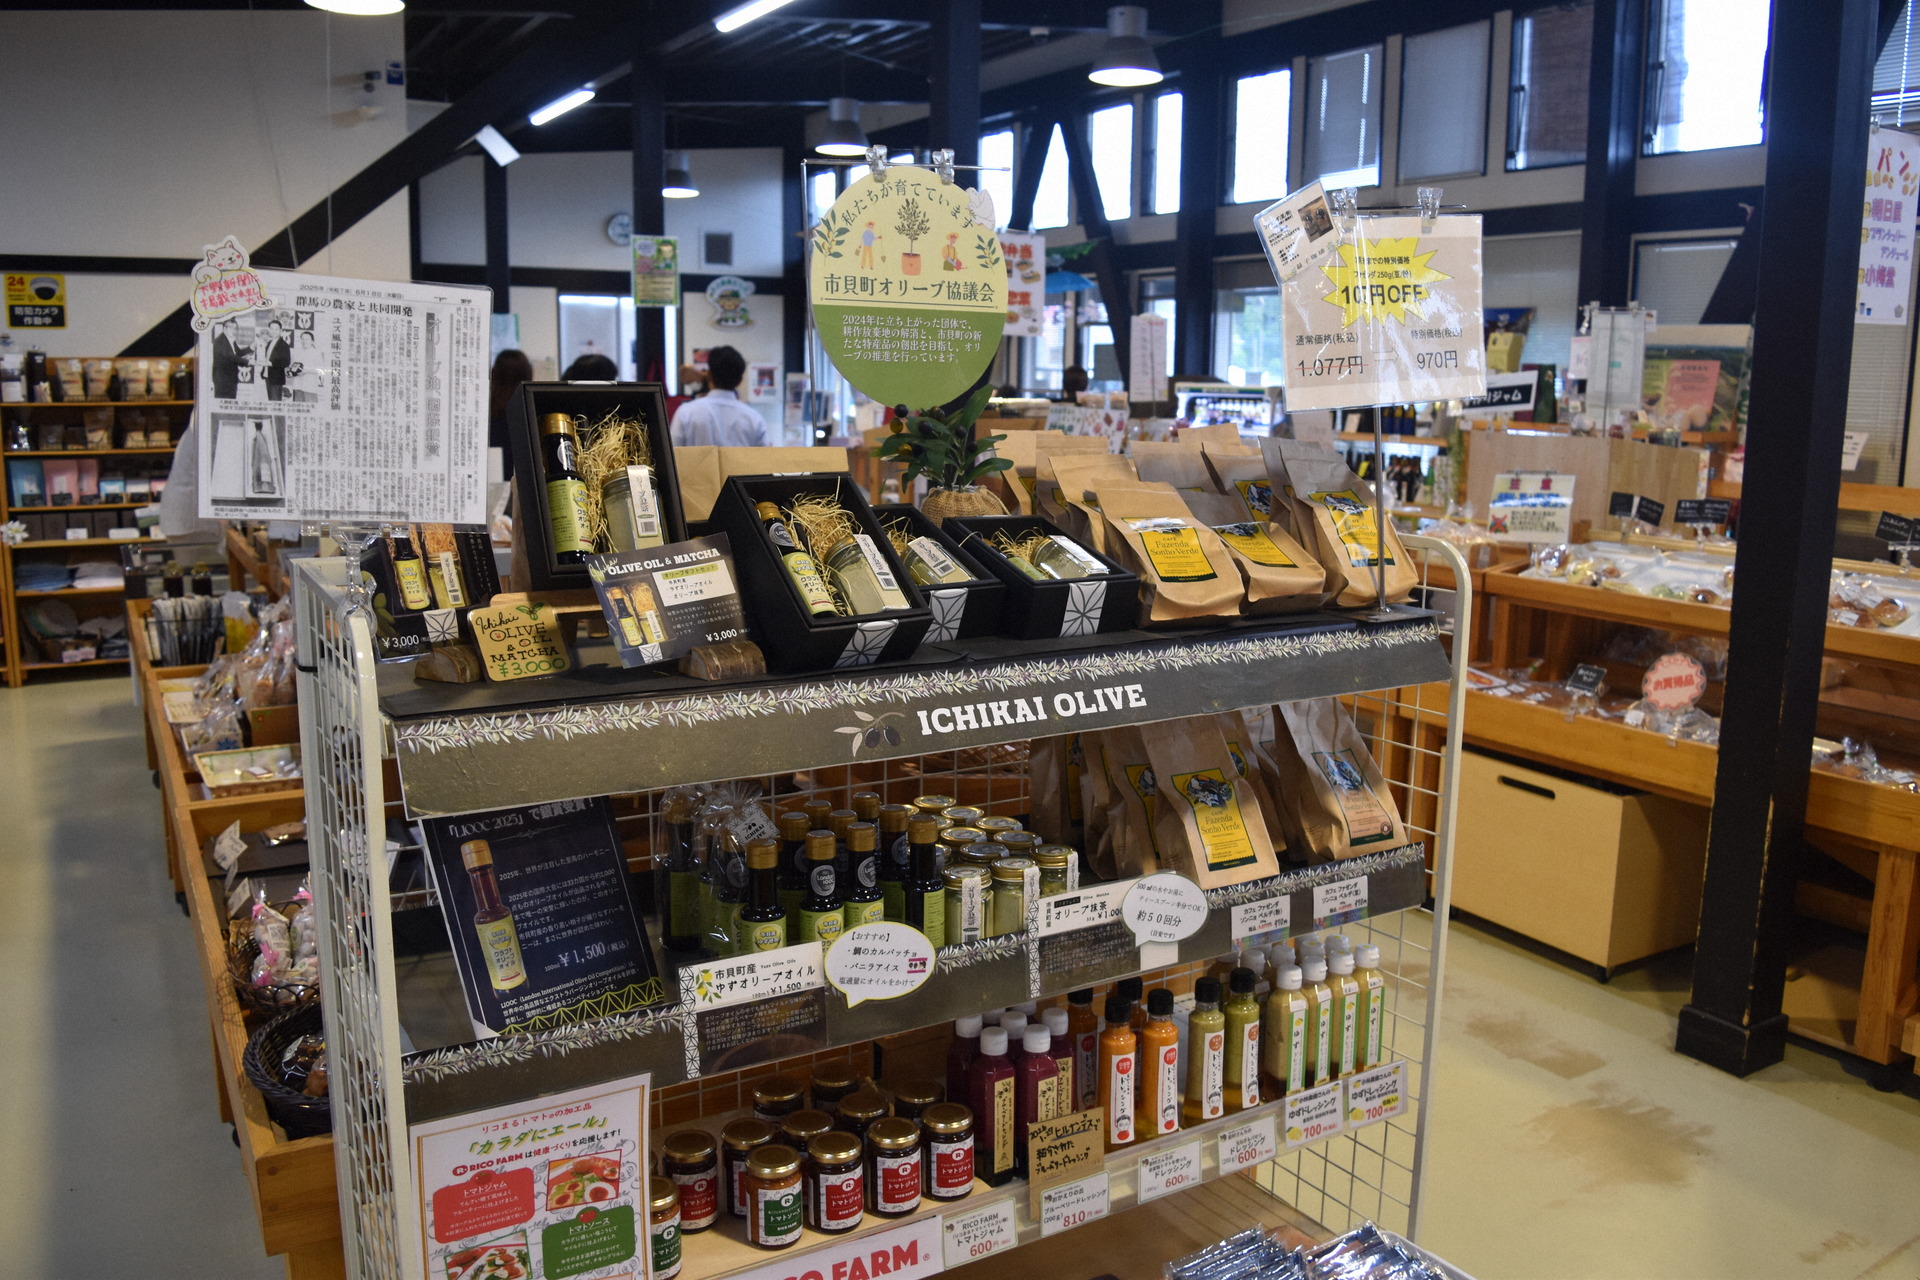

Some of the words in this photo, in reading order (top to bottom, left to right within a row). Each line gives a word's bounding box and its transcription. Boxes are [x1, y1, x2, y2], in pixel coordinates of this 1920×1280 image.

[841, 179, 974, 229] 私たちが育てています
[8, 276, 25, 287] 24
[824, 274, 995, 302] 市貝町オリーブ協議会
[14, 306, 59, 316] 防犯カメラ
[296, 296, 413, 317] 群馬の農家と共同開発
[24, 316, 52, 325] 作動中
[843, 314, 972, 330] 2024年に立ち上がった団体で、
[843, 326, 982, 341] 耕作放棄地の解消と、市貝町の新
[1295, 332, 1359, 346] 通常価格(税込)
[1411, 328, 1463, 340] 特別価格(税込)
[843, 338, 981, 352] たな特産品の創出を目指し、オリ
[843, 350, 959, 363] ーブの推進を行っています。
[1416, 350, 1458, 369] 970円
[1150, 547, 1175, 556] Sonho
[1176, 546, 1200, 556] Verde
[1154, 540, 1190, 549] Fazenda
[608, 562, 643, 576] OLIVE
[643, 559, 665, 570] OIL
[665, 557, 673, 565] &
[674, 548, 721, 564] MATCHA
[489, 622, 548, 642] OLIVE
[706, 628, 738, 643] ¥3,000
[382, 634, 419, 650] ¥3,000
[518, 635, 552, 648] OIL
[490, 646, 560, 663] MATCHA
[916, 696, 1048, 736] ICHIKAI
[1053, 683, 1147, 718] OLIVE
[1205, 814, 1233, 824] Fazenda
[1201, 825, 1221, 834] Sonho
[1221, 822, 1242, 831] Verde
[1325, 887, 1337, 895] カフェ
[1054, 901, 1108, 921] オリーブ抹茶
[851, 931, 890, 942] 【おすすめ】
[714, 963, 757, 981] 市貝町産
[716, 965, 816, 994] ゆずオリーブオイル
[770, 982, 802, 995] ¥1,500
[839, 976, 916, 987] 塩適量にオイルをかけて
[1351, 1079, 1397, 1100] ゆずドレッシング
[1289, 1096, 1337, 1119] ゆずドレッシング
[469, 1114, 609, 1156] 「カラダにエール」
[1036, 1140, 1075, 1161] 紹介された
[1230, 1135, 1267, 1155] ドレッシング
[469, 1159, 494, 1172] RICO
[496, 1153, 524, 1166] FARM
[941, 1162, 972, 1174] トマトジャム
[1154, 1159, 1193, 1179] ドレッシング
[462, 1180, 509, 1198] トマトジャム
[887, 1177, 919, 1190] トマトジャム
[831, 1193, 862, 1206] トマトジャム
[1043, 1188, 1107, 1214] ブルーベリードレッシング
[770, 1209, 800, 1223] トマトソース
[962, 1219, 979, 1231] RICO
[980, 1213, 999, 1225] FARM
[568, 1216, 611, 1234] トマトソース
[957, 1225, 1004, 1247] トマトジャム
[832, 1239, 919, 1280] FARM
